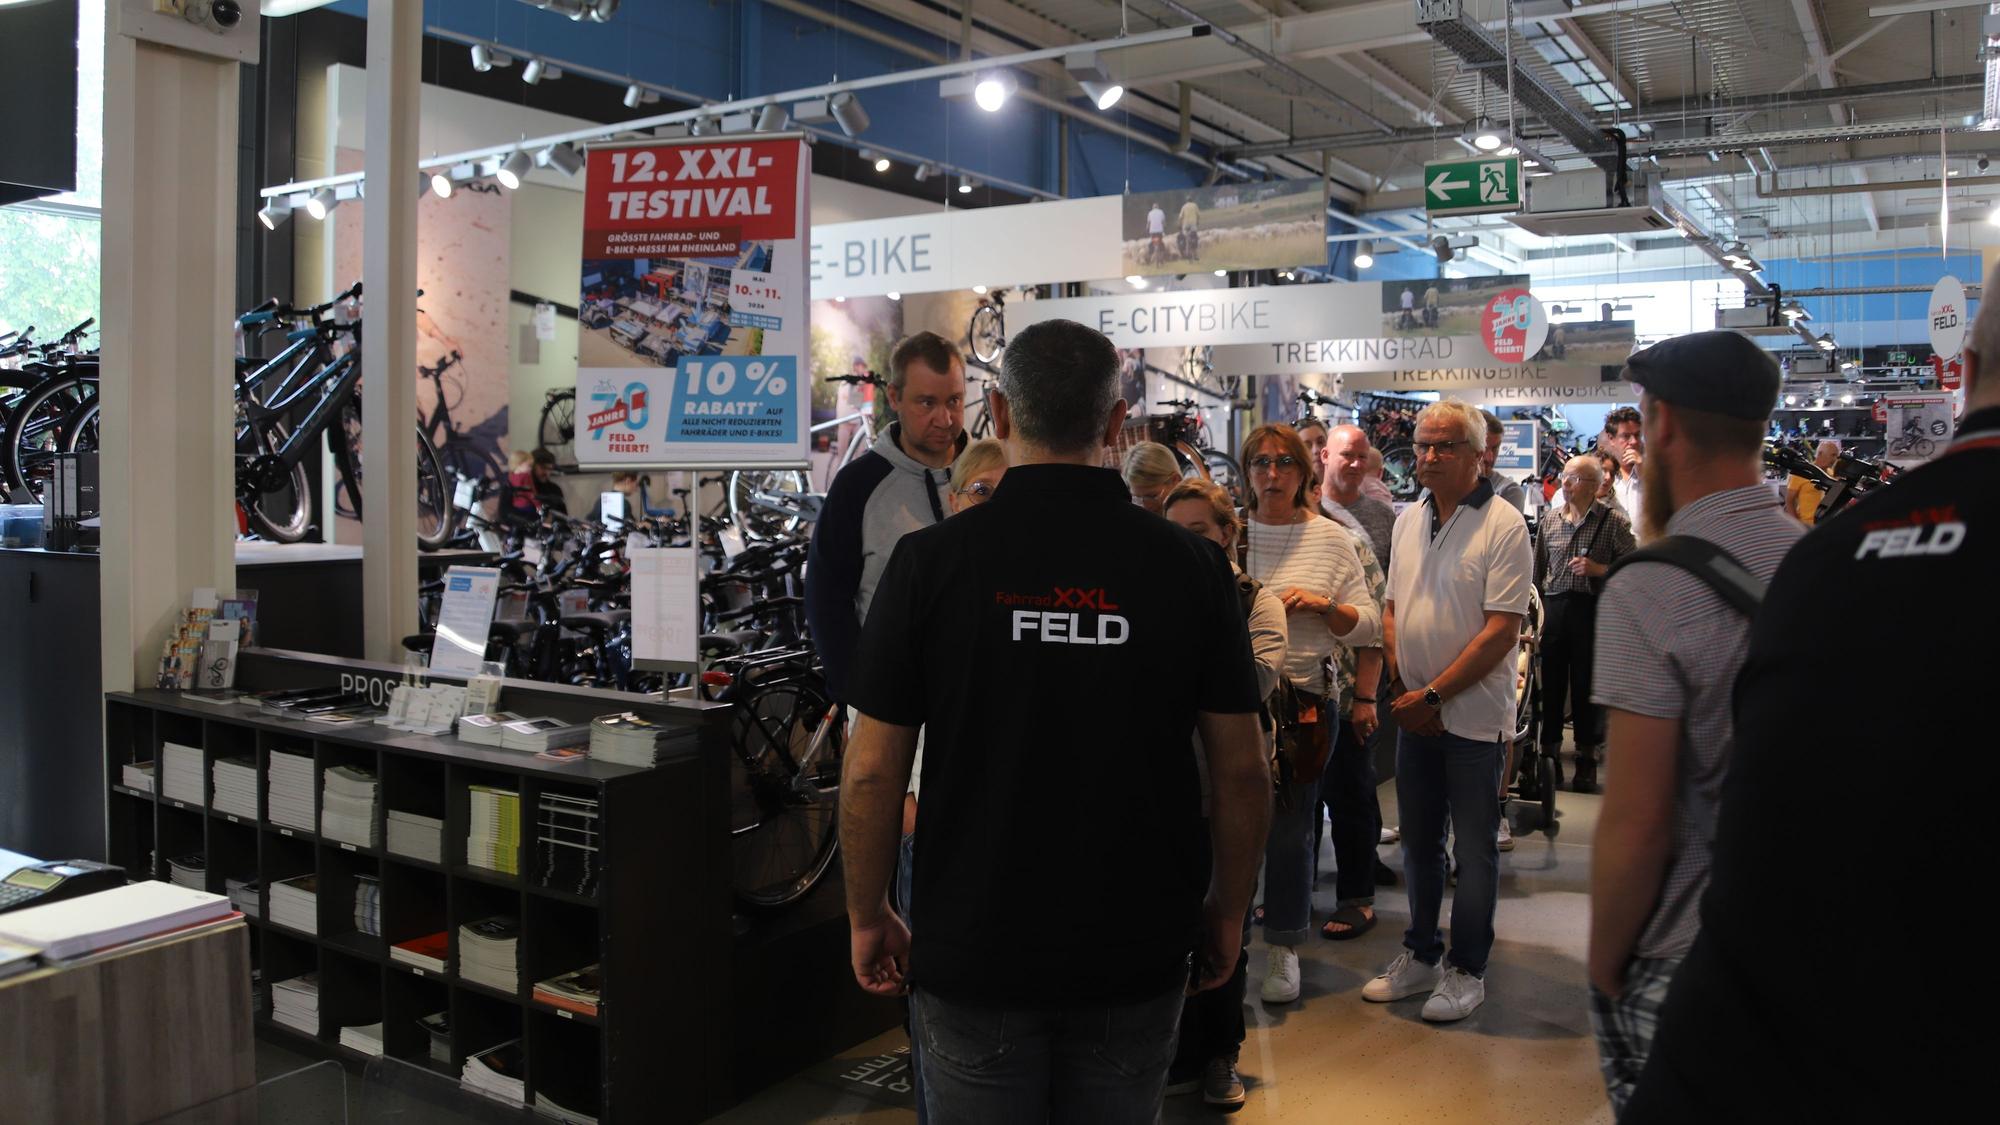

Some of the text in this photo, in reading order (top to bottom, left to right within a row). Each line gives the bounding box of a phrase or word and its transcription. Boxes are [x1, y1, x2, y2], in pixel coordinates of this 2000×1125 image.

[611, 147, 773, 183] 12. XXL-
[608, 186, 772, 219] TESTIVAL
[608, 231, 720, 243] GRÖSSTE FAHRRAD- UND
[606, 243, 737, 255] E-BIKE-MESSE IM RHEINLAND
[811, 233, 931, 278] E-BIKE
[735, 284, 752, 296] 10.
[765, 288, 781, 300] 11.
[1099, 300, 1270, 335] E-CITYBIKE
[1934, 314, 1957, 330] FELD
[1272, 336, 1453, 364] TREKKINGRAD
[1494, 338, 1513, 346] FELD
[685, 361, 788, 396] 10 %
[1391, 367, 1549, 382] TREKKINGBIKE
[591, 381, 649, 441] 70
[592, 409, 625, 426] JAHRE
[766, 407, 784, 416] AUF
[728, 418, 782, 426] REDUZIERTEN
[609, 433, 635, 442] FELD
[681, 428, 727, 436] FAHRRÄDER
[750, 429, 783, 437] E-BIKES!
[608, 443, 649, 453] FEIERT!
[1854, 522, 1967, 561] FELD
[996, 587, 1119, 610] Fahrrad XXL
[1012, 610, 1130, 645] FELD
[340, 673, 396, 707] PROS
